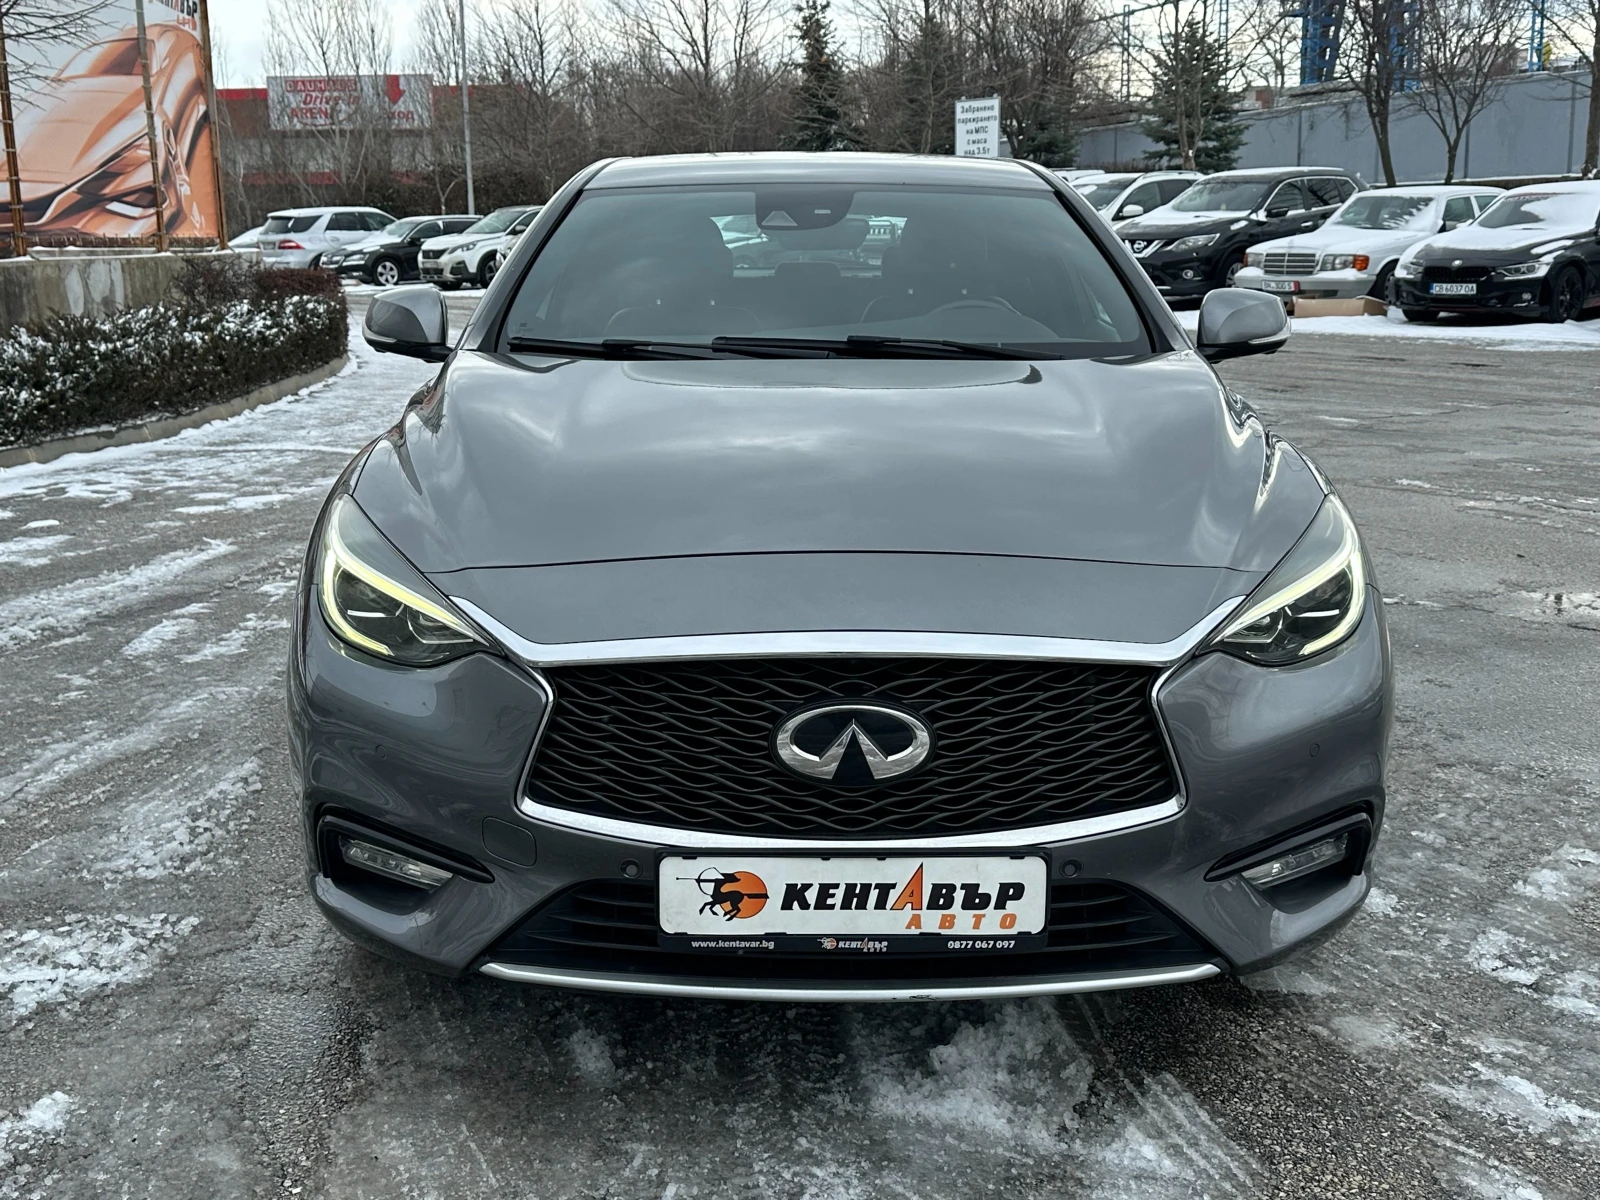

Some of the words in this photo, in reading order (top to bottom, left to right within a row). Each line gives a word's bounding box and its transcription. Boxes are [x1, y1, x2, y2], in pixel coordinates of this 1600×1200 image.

[290, 107, 338, 119] AREN
[960, 104, 995, 114] Забранено
[957, 115, 998, 125] паркирането
[974, 126, 988, 134] МПС
[780, 861, 1026, 911] КЕНТАВЪР
[905, 913, 1018, 930] АВТО
[691, 940, 775, 950] www.kentavar.bg
[947, 940, 974, 949] 0877
[974, 940, 996, 949] 067
[996, 940, 1016, 949] 097
